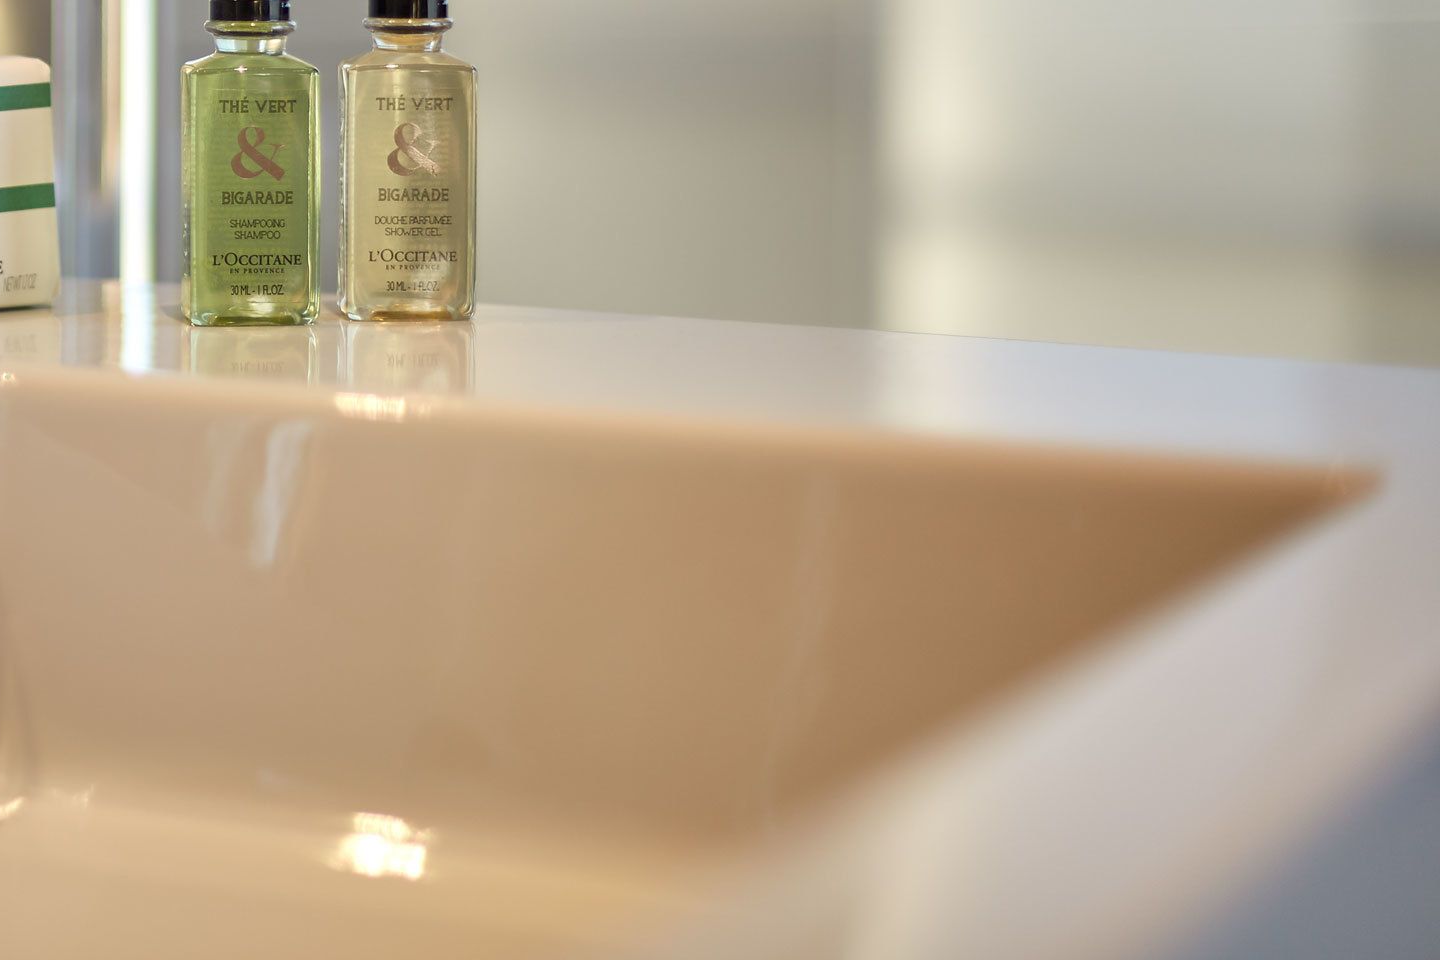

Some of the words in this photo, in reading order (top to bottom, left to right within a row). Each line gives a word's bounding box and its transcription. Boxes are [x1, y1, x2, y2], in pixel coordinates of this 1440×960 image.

[218, 96, 249, 114] THÉ
[254, 99, 297, 114] VERT
[375, 94, 406, 111] THÉ
[411, 97, 454, 111] VERT
[230, 126, 286, 181] &
[386, 122, 441, 177] &
[221, 191, 294, 205] BIGARADE
[377, 188, 450, 202] BIGARADE
[374, 215, 408, 225] DOUCHE
[234, 230, 281, 240] SHAMPOO
[384, 227, 423, 236] SHOWER
[212, 252, 302, 266] L'OCCITANE
[368, 248, 458, 262] L'OCCITANE
